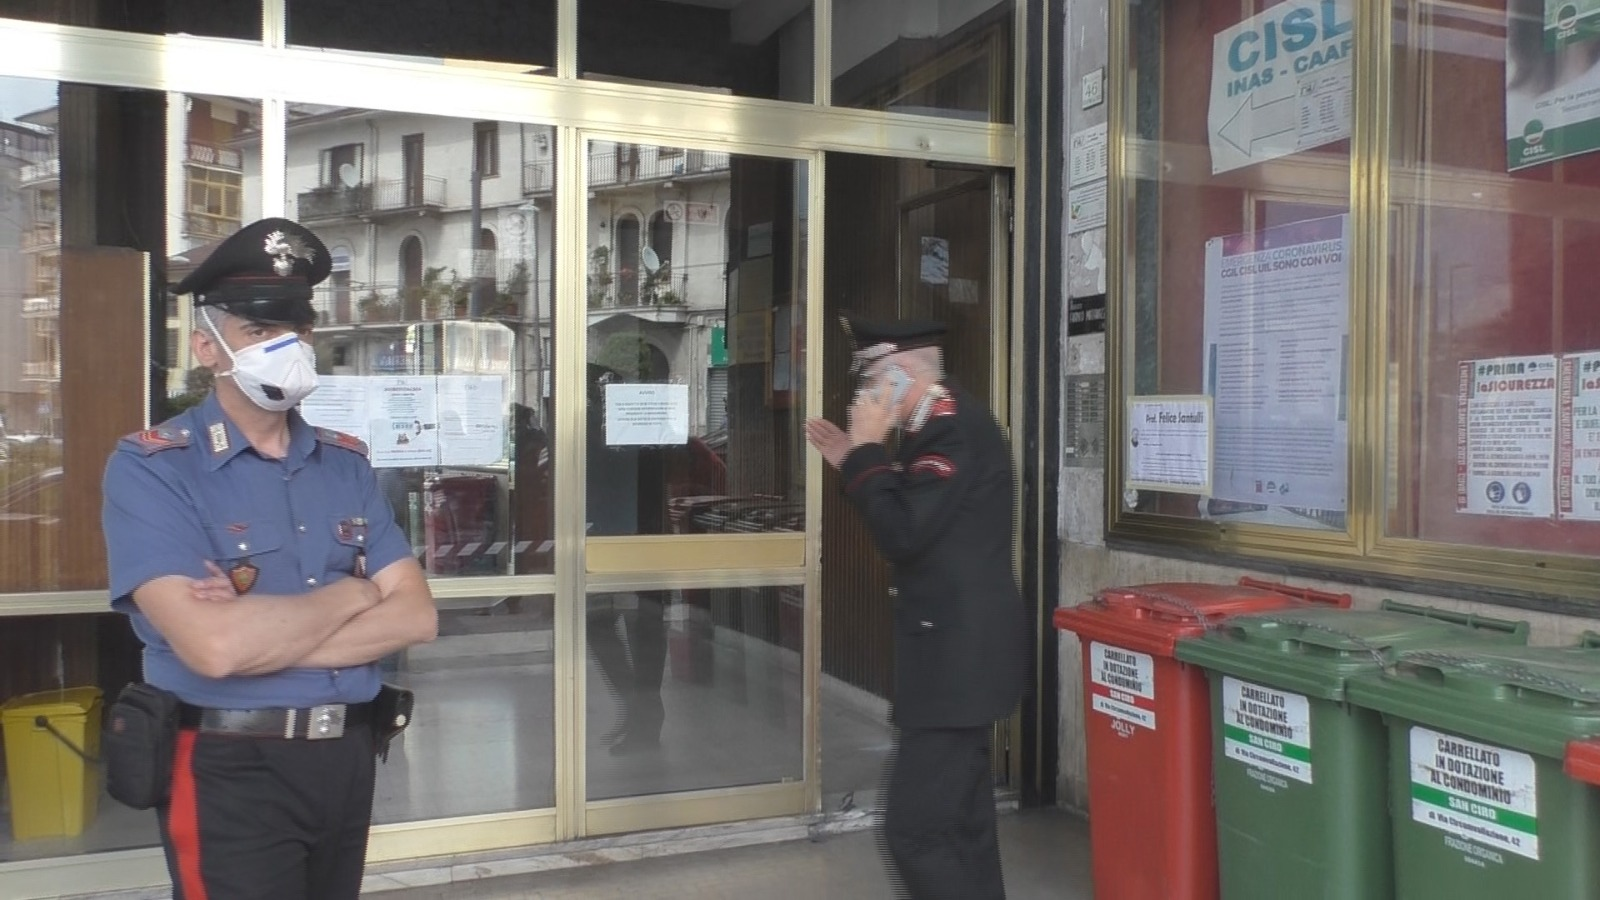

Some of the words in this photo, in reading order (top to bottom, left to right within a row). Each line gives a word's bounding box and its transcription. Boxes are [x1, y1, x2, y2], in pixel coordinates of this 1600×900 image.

[1227, 0, 1353, 72] CISL
[1557, 27, 1578, 39] CISL
[1227, 67, 1273, 97] INAS
[1293, 40, 1353, 73] CAAF
[1523, 145, 1546, 156] CISL
[1272, 240, 1343, 260] CORONAVIRUS
[1221, 267, 1239, 279] CGIL
[1239, 264, 1257, 276] CISL
[1258, 262, 1271, 273] UIL
[1272, 258, 1299, 271] SONO
[1301, 255, 1321, 267] CON
[1323, 252, 1342, 264] VOI
[1478, 362, 1525, 376] #PRIMA
[1159, 411, 1177, 423] Felice
[1104, 649, 1136, 666] CARRELLATO
[1103, 660, 1108, 671] IN
[1110, 661, 1138, 678] DOTAZIONE
[1108, 673, 1142, 692] CONDOMINIO
[1110, 689, 1120, 698] SAN
[1241, 686, 1284, 708] CARRELLATO
[1240, 699, 1246, 711] IN
[1248, 701, 1288, 723] DOTAZIONE
[1110, 719, 1135, 735] JOLLY
[1236, 710, 1244, 725] AL
[1245, 715, 1293, 739] CONDOMINIO
[1249, 734, 1262, 746] SAN
[1264, 738, 1282, 752] CIRO
[1438, 739, 1500, 767] CARRELLATO
[1436, 755, 1445, 769] IN
[1448, 758, 1504, 785] DOTAZIONE
[1430, 769, 1441, 785] AL
[1443, 773, 1511, 805] CONDOMINIO
[1448, 797, 1469, 812] SAN
[1470, 803, 1496, 820] CIRO
